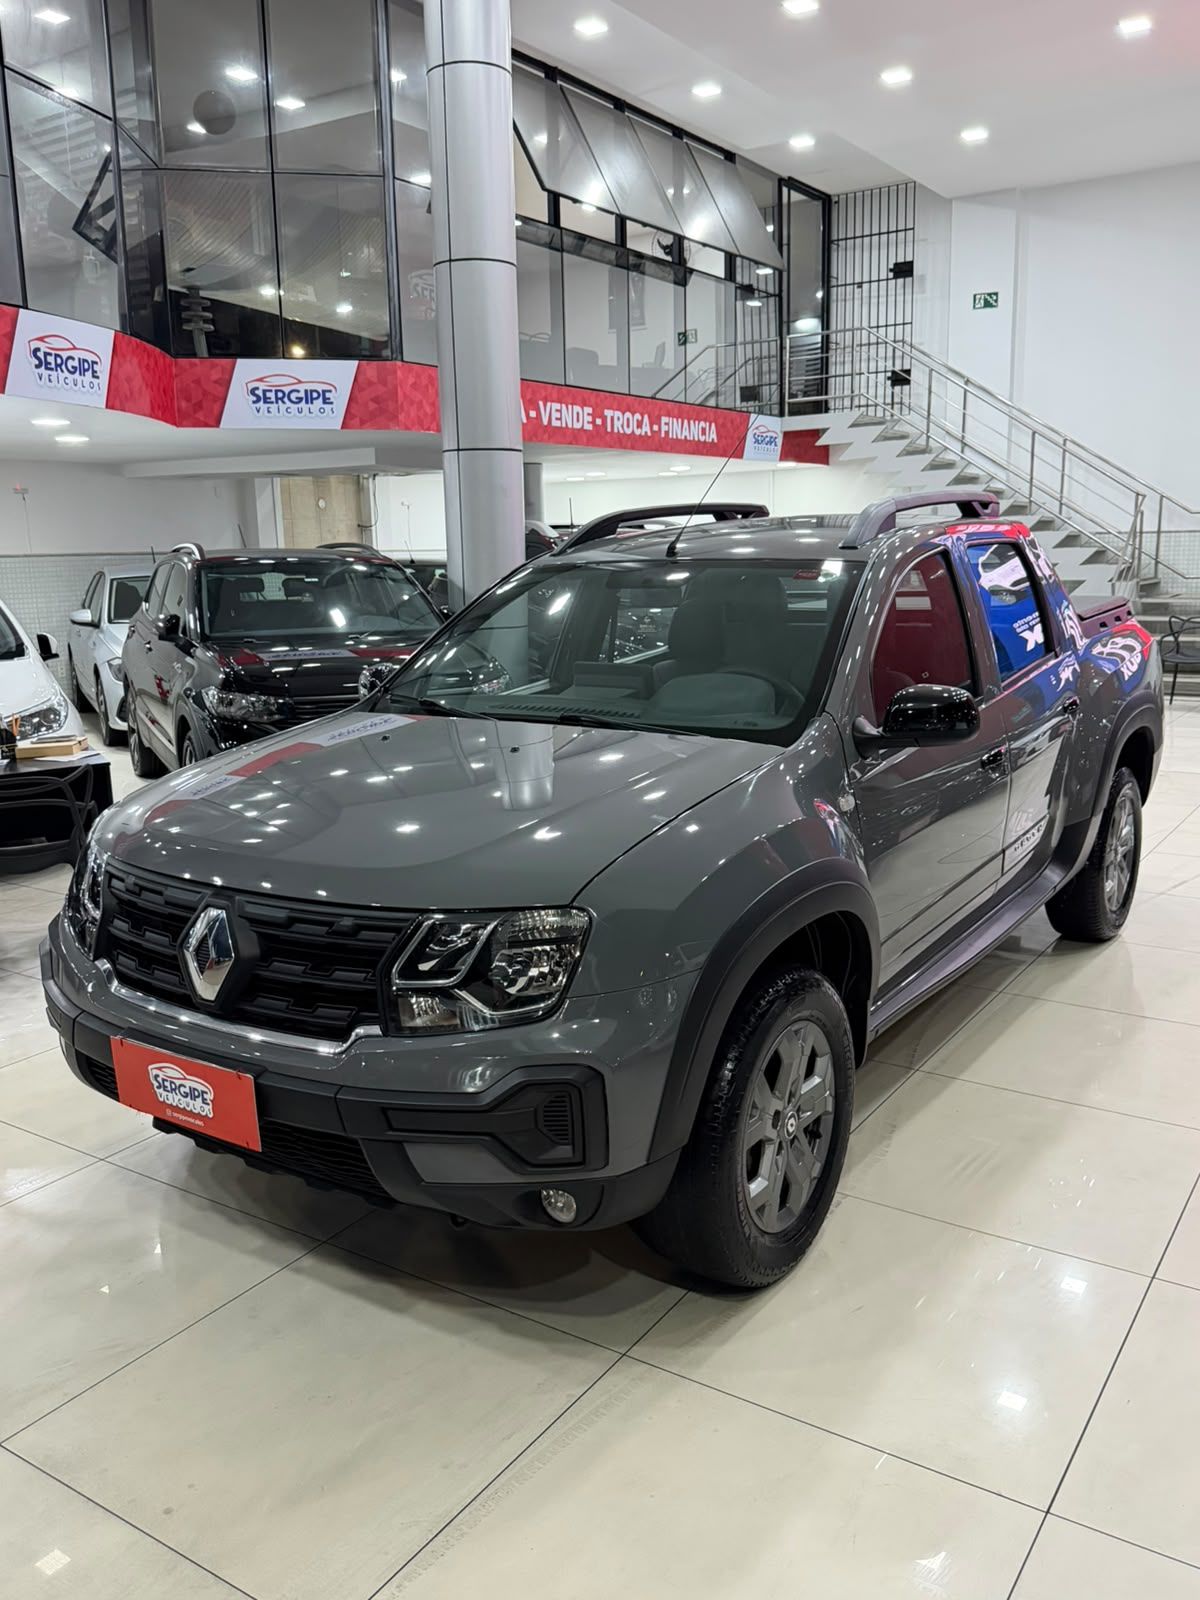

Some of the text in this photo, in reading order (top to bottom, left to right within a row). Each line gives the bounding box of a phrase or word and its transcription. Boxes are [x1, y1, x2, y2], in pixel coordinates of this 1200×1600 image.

[32, 346, 100, 380] SERGIPE
[249, 386, 334, 406] SERGIPE
[538, 400, 593, 431] VENDE
[604, 408, 652, 437] TROCA
[661, 415, 718, 443] FINANCIA
[153, 1073, 211, 1106] SERGIPE
